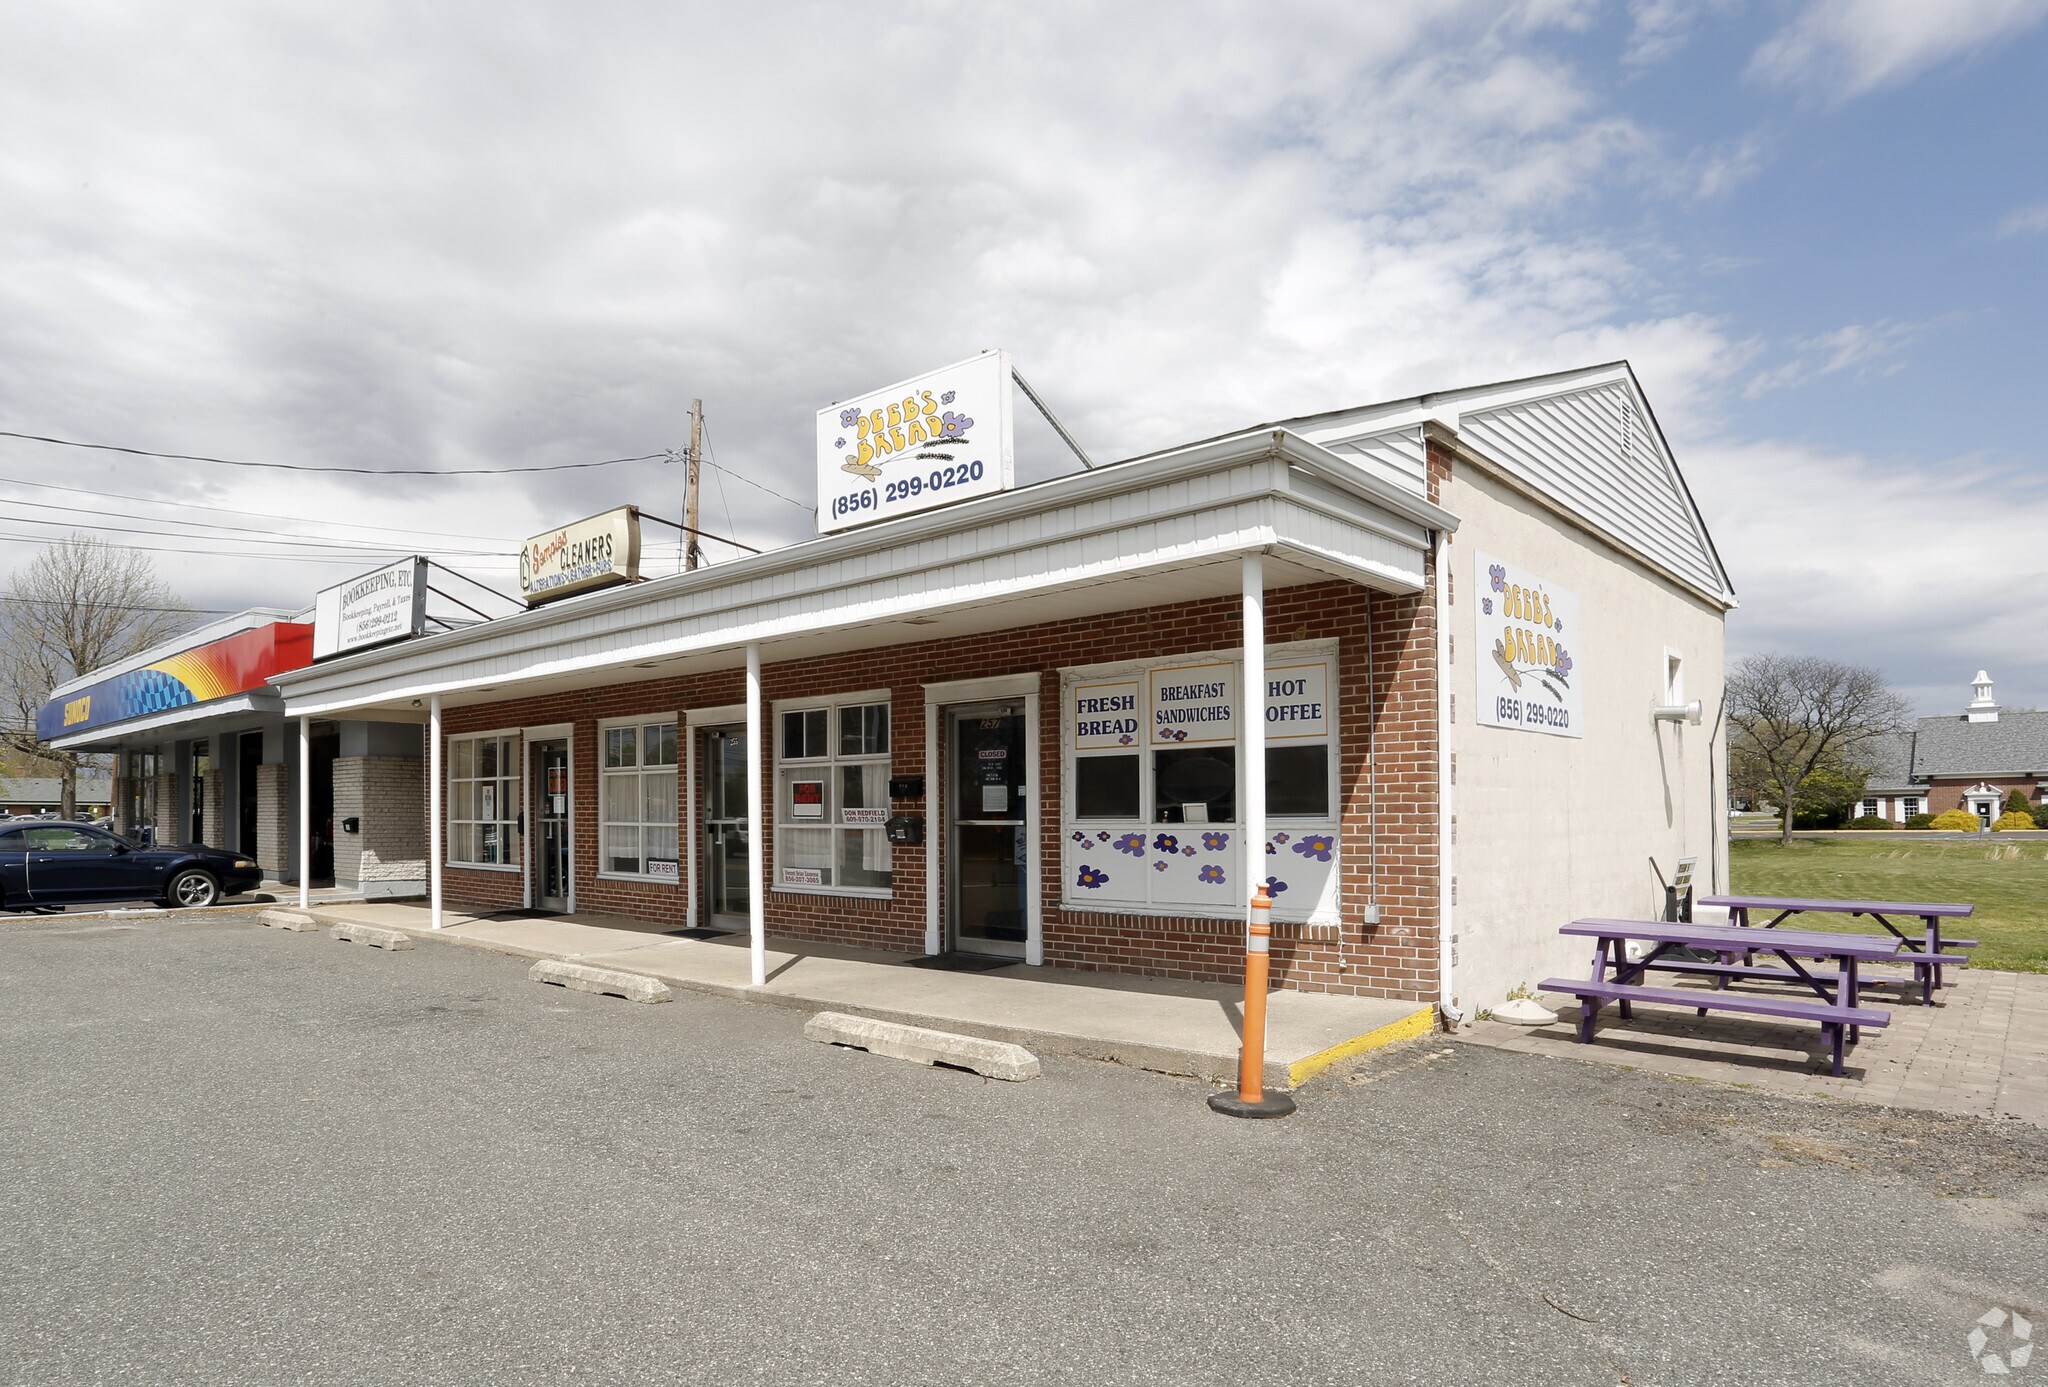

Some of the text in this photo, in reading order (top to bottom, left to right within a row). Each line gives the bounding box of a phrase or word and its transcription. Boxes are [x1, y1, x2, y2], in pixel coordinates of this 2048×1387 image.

[857, 390, 938, 439] DEEB'S
[856, 416, 943, 465] BREAD
[832, 460, 984, 520] (856) 299-0220
[560, 533, 613, 571] CLEANERS
[342, 571, 396, 610] BOOKKEEPING,
[1503, 583, 1553, 628] DEEB'S
[1504, 626, 1557, 667] BREAD
[1160, 682, 1226, 702] BREAKFAST
[1268, 679, 1307, 698] HOT
[64, 696, 91, 727] SUNOCO
[1077, 695, 1135, 714] FRESH
[1265, 703, 1322, 722] OFFEE
[1496, 696, 1569, 729] (856) 299-0220
[980, 718, 1000, 728] 257
[1156, 705, 1231, 725] SANDWICHES
[1077, 718, 1138, 737] BREAD
[980, 750, 1006, 758] CLOSED
[795, 794, 820, 803] RENT
[799, 784, 817, 793] FOR
[650, 863, 677, 874] FOR RENT
